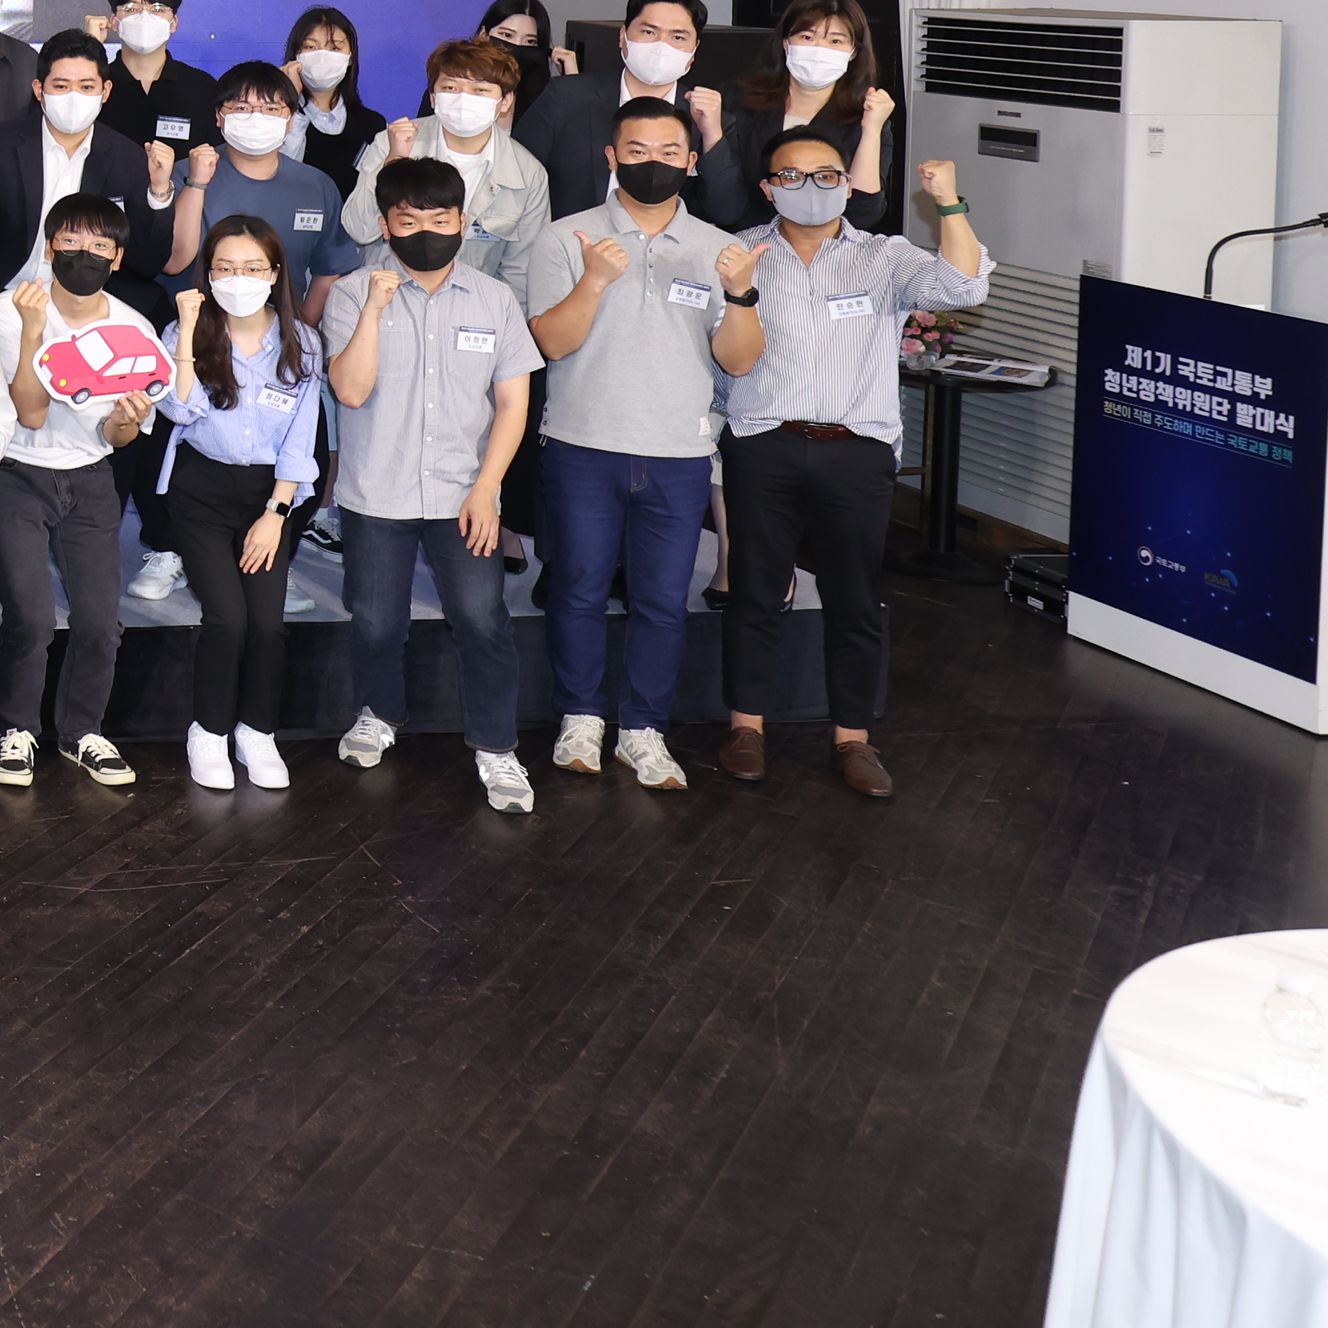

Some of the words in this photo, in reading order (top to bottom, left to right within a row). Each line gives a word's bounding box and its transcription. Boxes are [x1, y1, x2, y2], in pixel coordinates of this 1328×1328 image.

[1124, 344, 1172, 376] 제1기
[1177, 356, 1273, 400] 국토교통부
[1103, 400, 1131, 419] 청년이
[1133, 409, 1152, 425] 직접
[1154, 414, 1193, 437] 주도하며
[1195, 425, 1225, 446] 만드는
[1227, 433, 1269, 457] 국토교통
[1271, 445, 1294, 464] 정책
[1104, 368, 1231, 422] 청년정책위원단
[1235, 401, 1295, 440] 발대식
[1155, 555, 1186, 573] 국토교통부
